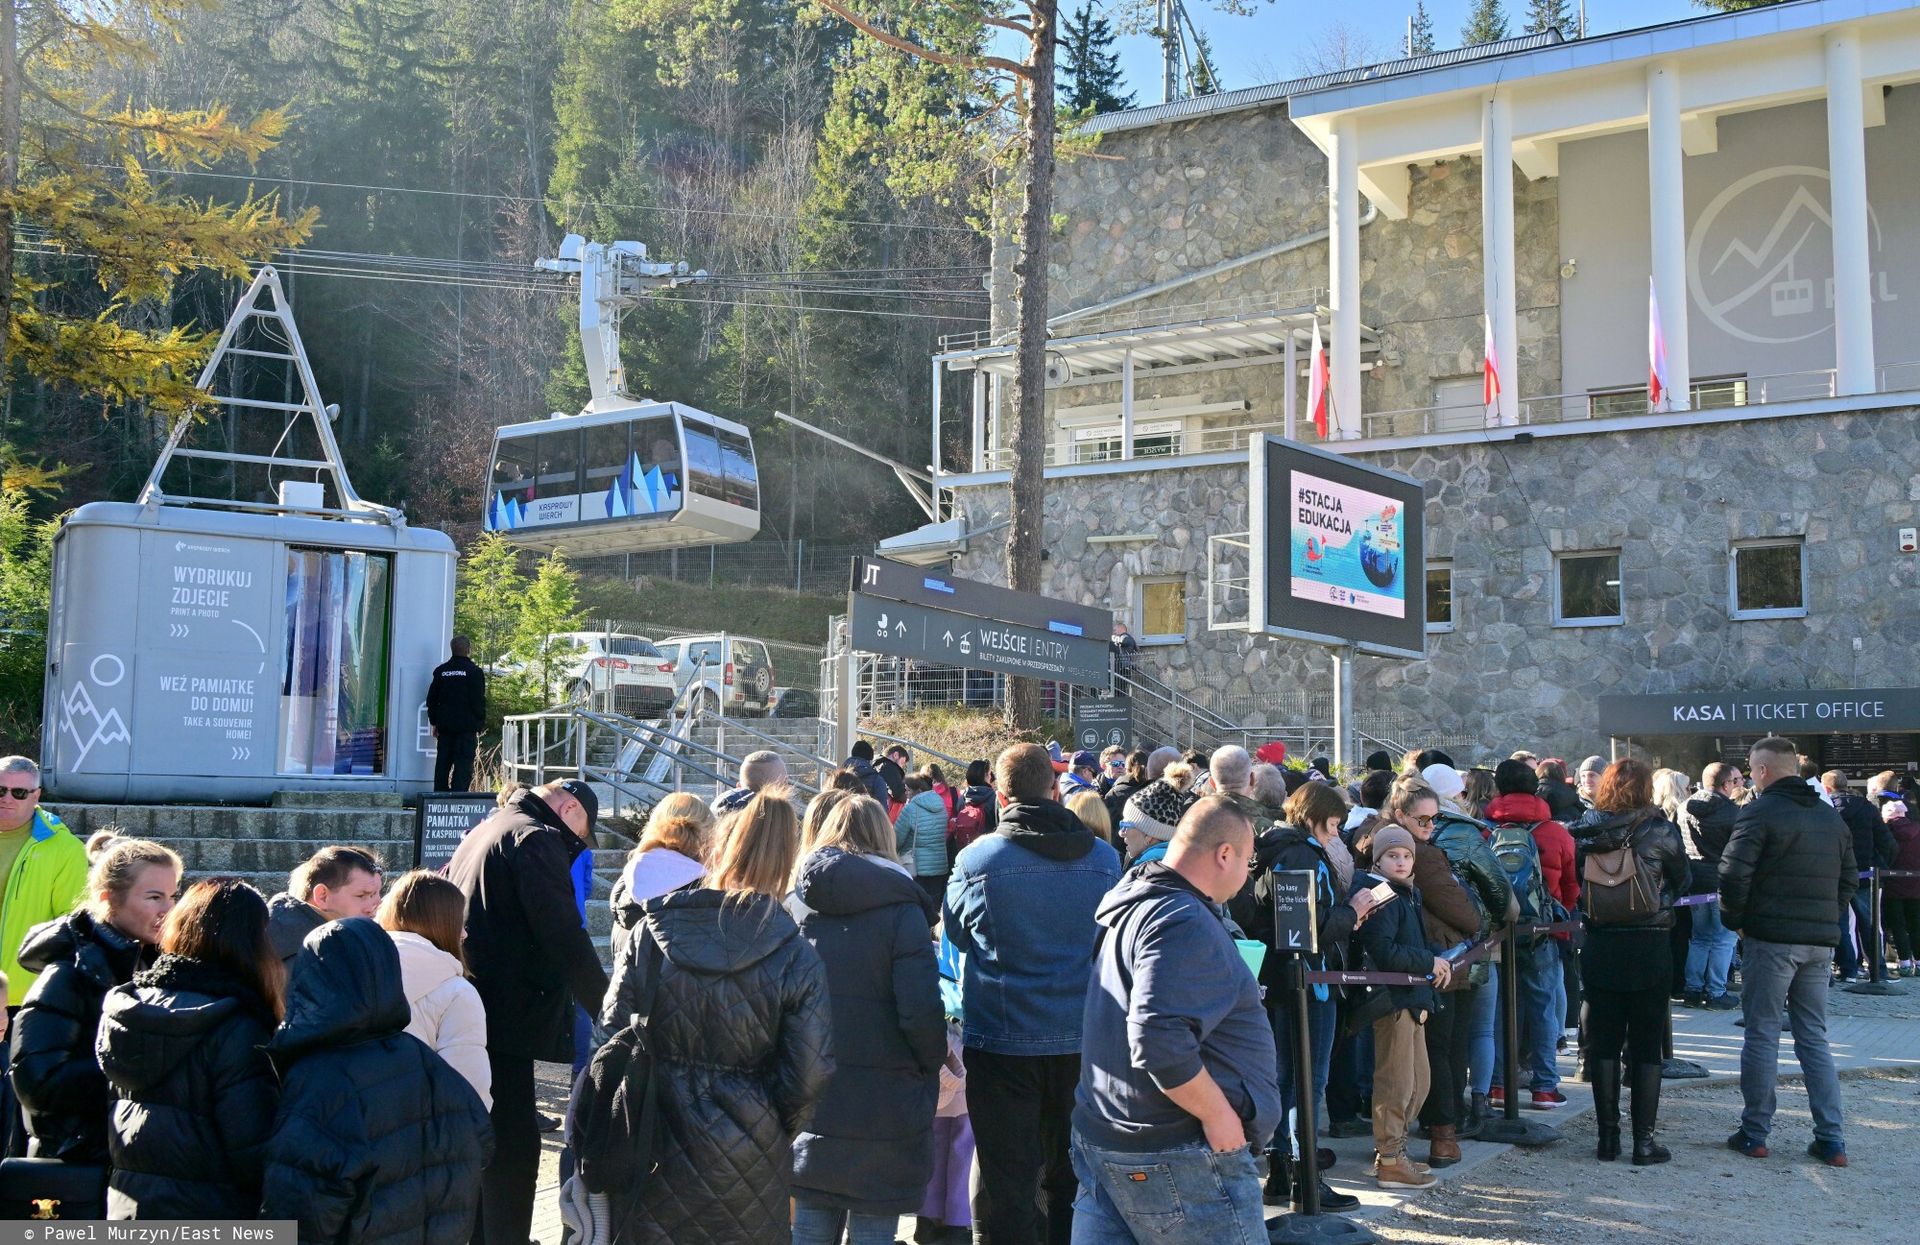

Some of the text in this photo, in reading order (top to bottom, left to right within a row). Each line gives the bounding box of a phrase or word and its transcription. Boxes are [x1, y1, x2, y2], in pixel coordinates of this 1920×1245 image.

[539, 500, 573, 511] KASPROWY
[1298, 487, 1343, 513] #STACJA
[539, 512, 563, 521] WIERCH
[1298, 507, 1352, 535] EDUKACJA
[173, 566, 252, 588] WYDRUKUJ
[171, 587, 230, 607] ZDJĘCIE
[171, 607, 220, 618] PRINT A PHOTO
[979, 628, 1070, 661] WEJŚCIE ENTRY
[979, 652, 996, 662] BILETY
[996, 654, 1021, 666] ZAKUPIONE
[160, 675, 187, 692] WEŹ
[191, 697, 254, 713] DO DOMU!
[1673, 701, 1884, 721] KASA TICKET OFFICE
[183, 716, 252, 729] TAKE A SOUVENIR
[226, 729, 252, 740] HOME!
[428, 804, 486, 814] TWOJA NIEZWYKŁA
[425, 830, 430, 838] Z
[1286, 883, 1298, 893] kasy
[1278, 895, 1284, 903] To
[1278, 903, 1293, 912] office
